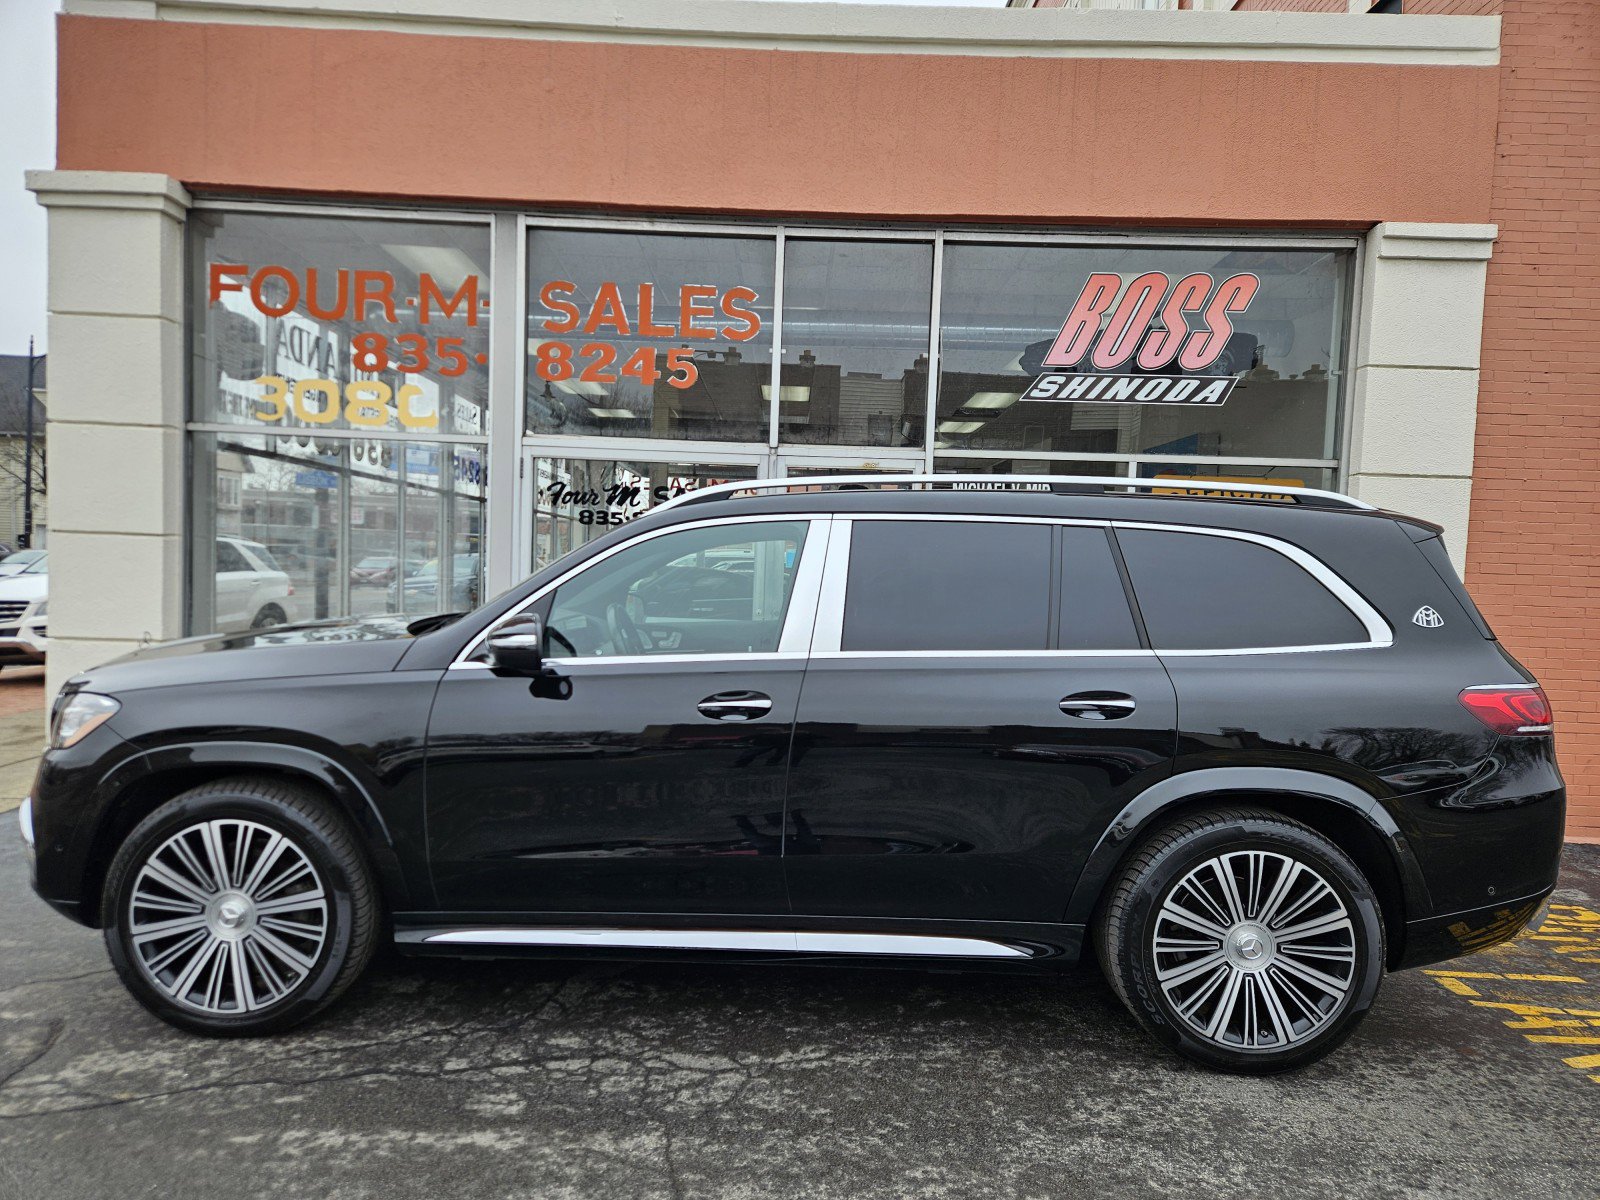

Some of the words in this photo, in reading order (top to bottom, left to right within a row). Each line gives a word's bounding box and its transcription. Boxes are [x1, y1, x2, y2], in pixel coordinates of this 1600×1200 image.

[538, 279, 760, 343] SALES
[1042, 270, 1261, 372] BOSS
[536, 341, 699, 389] 8245
[1029, 376, 1229, 404] SHINODA
[547, 481, 600, 506] Four
[602, 483, 641, 507] M
